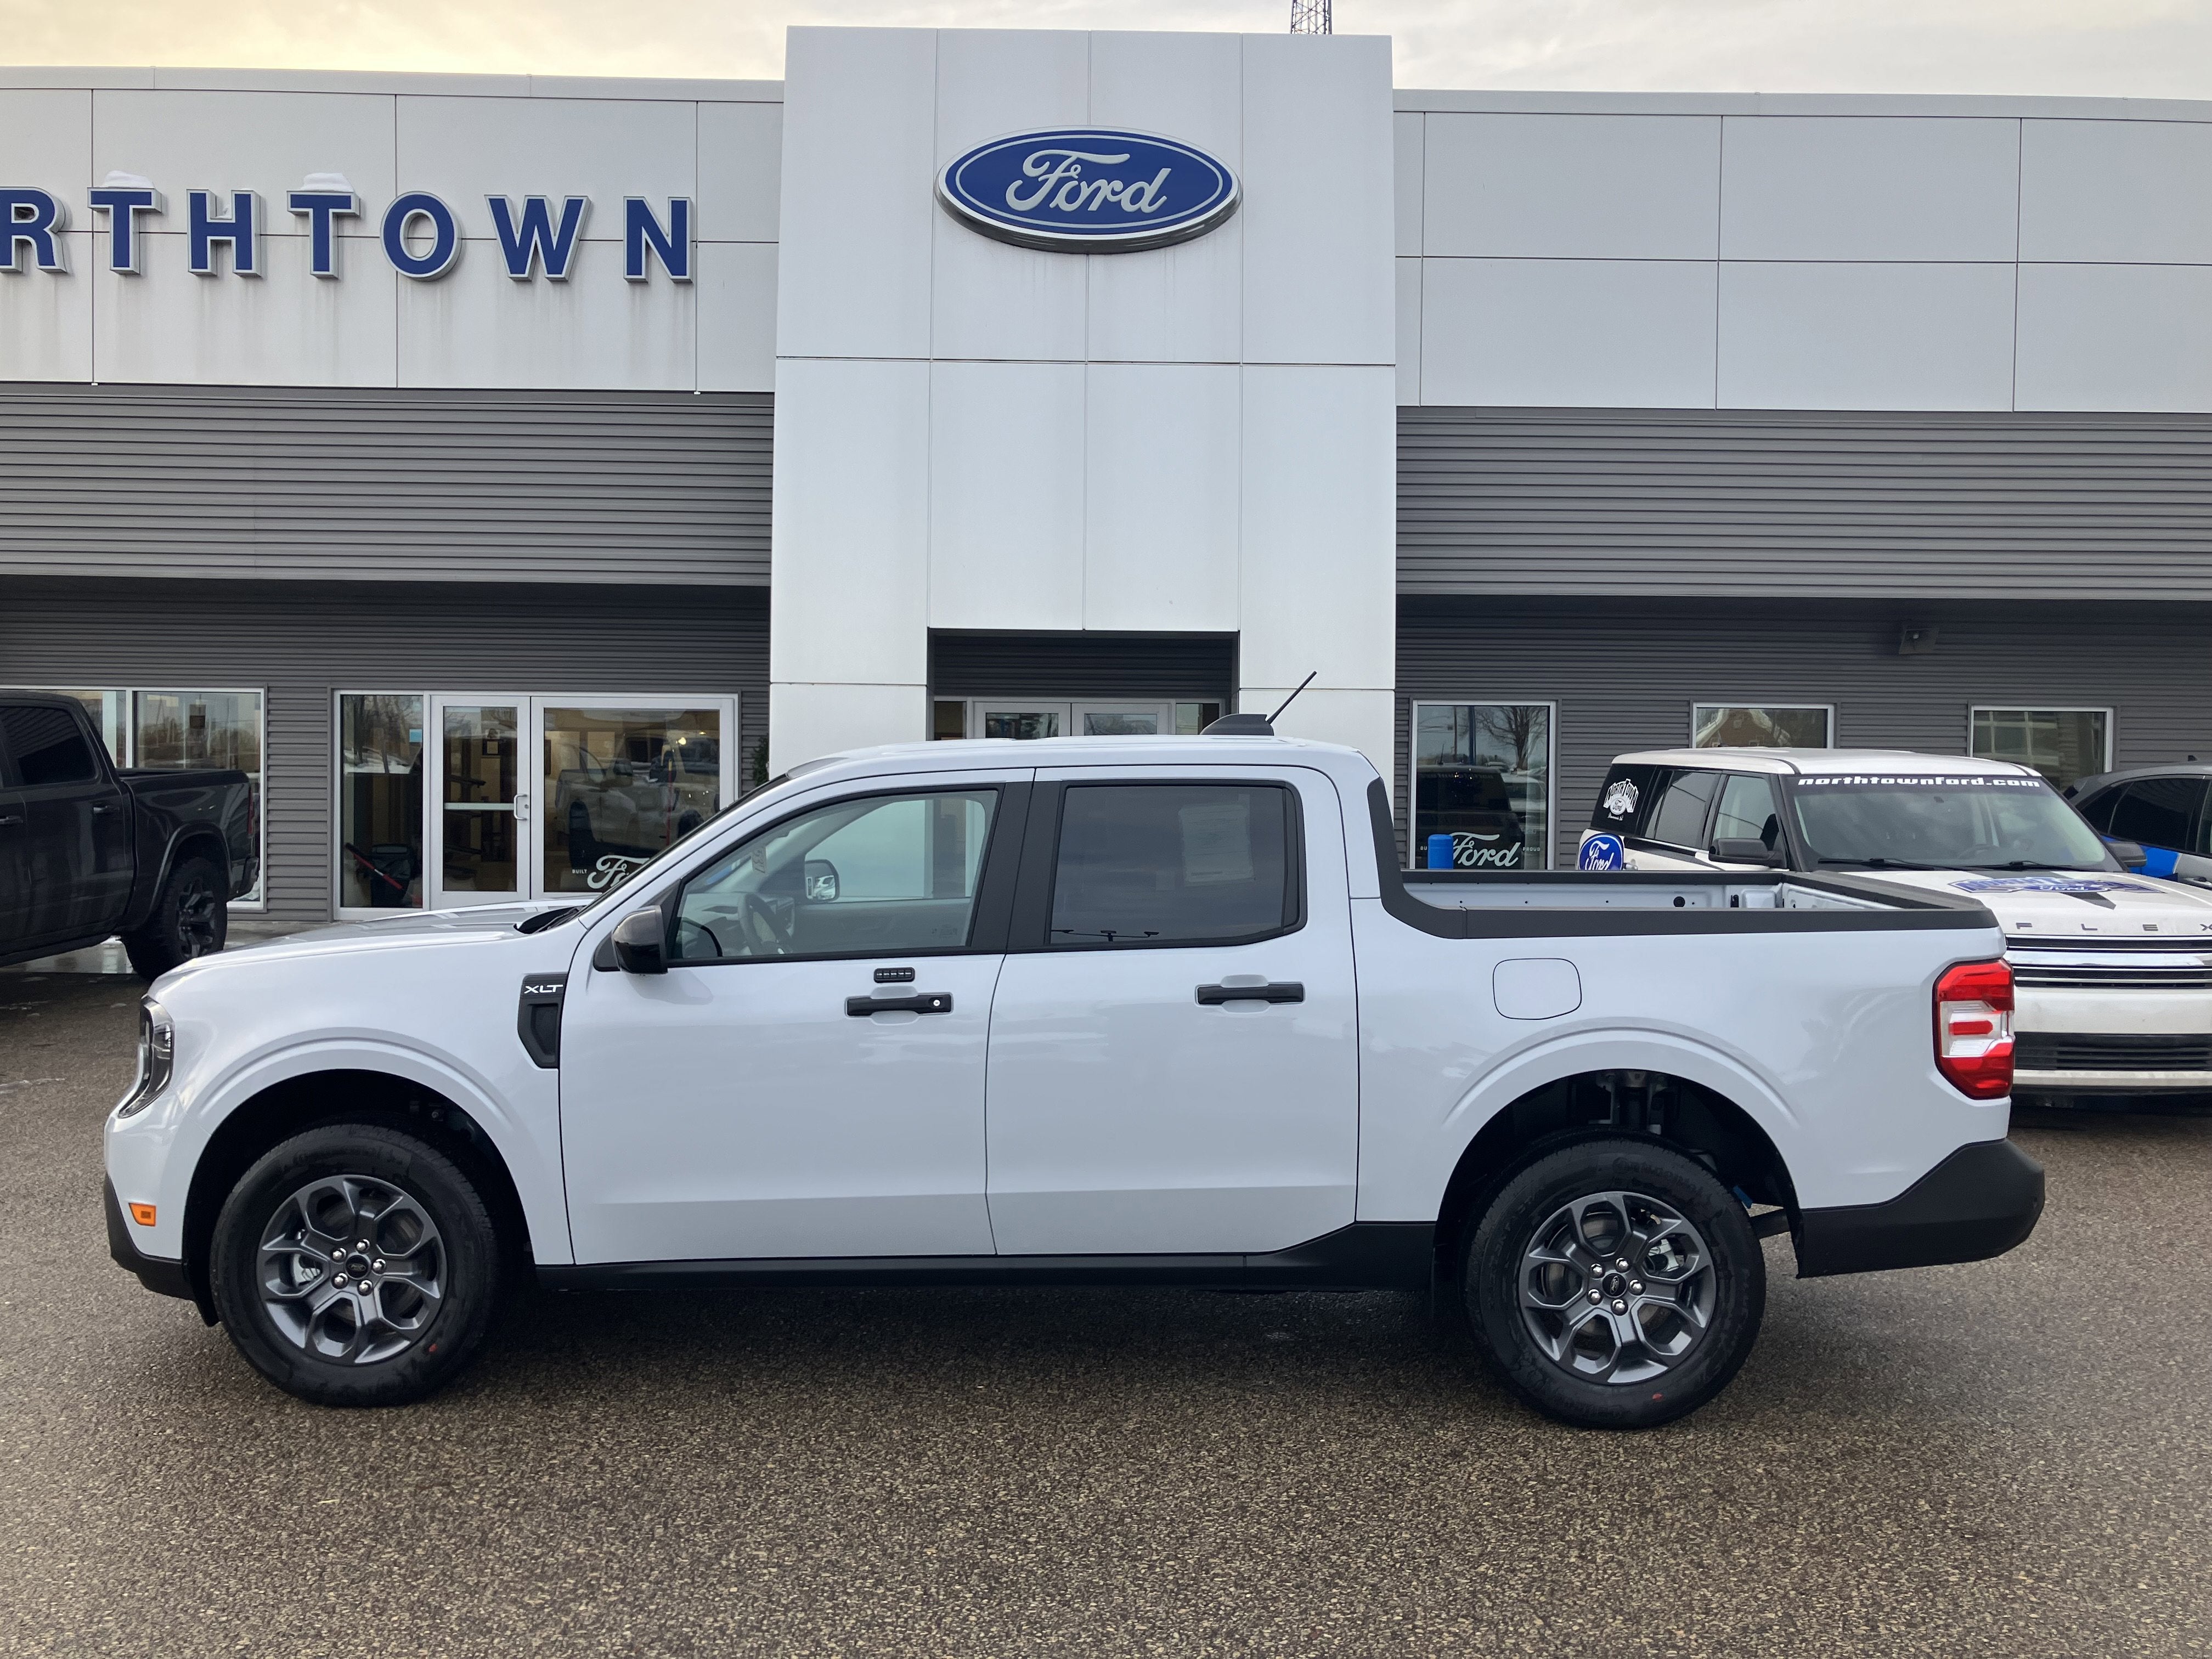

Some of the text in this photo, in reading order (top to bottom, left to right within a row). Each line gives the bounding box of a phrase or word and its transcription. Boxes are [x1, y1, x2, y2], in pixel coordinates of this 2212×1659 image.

[1006, 149, 1171, 213] Ford
[1798, 776, 2040, 787] northtownford.com
[2016, 922, 2212, 932] FLEX
[524, 984, 563, 994] XLT
